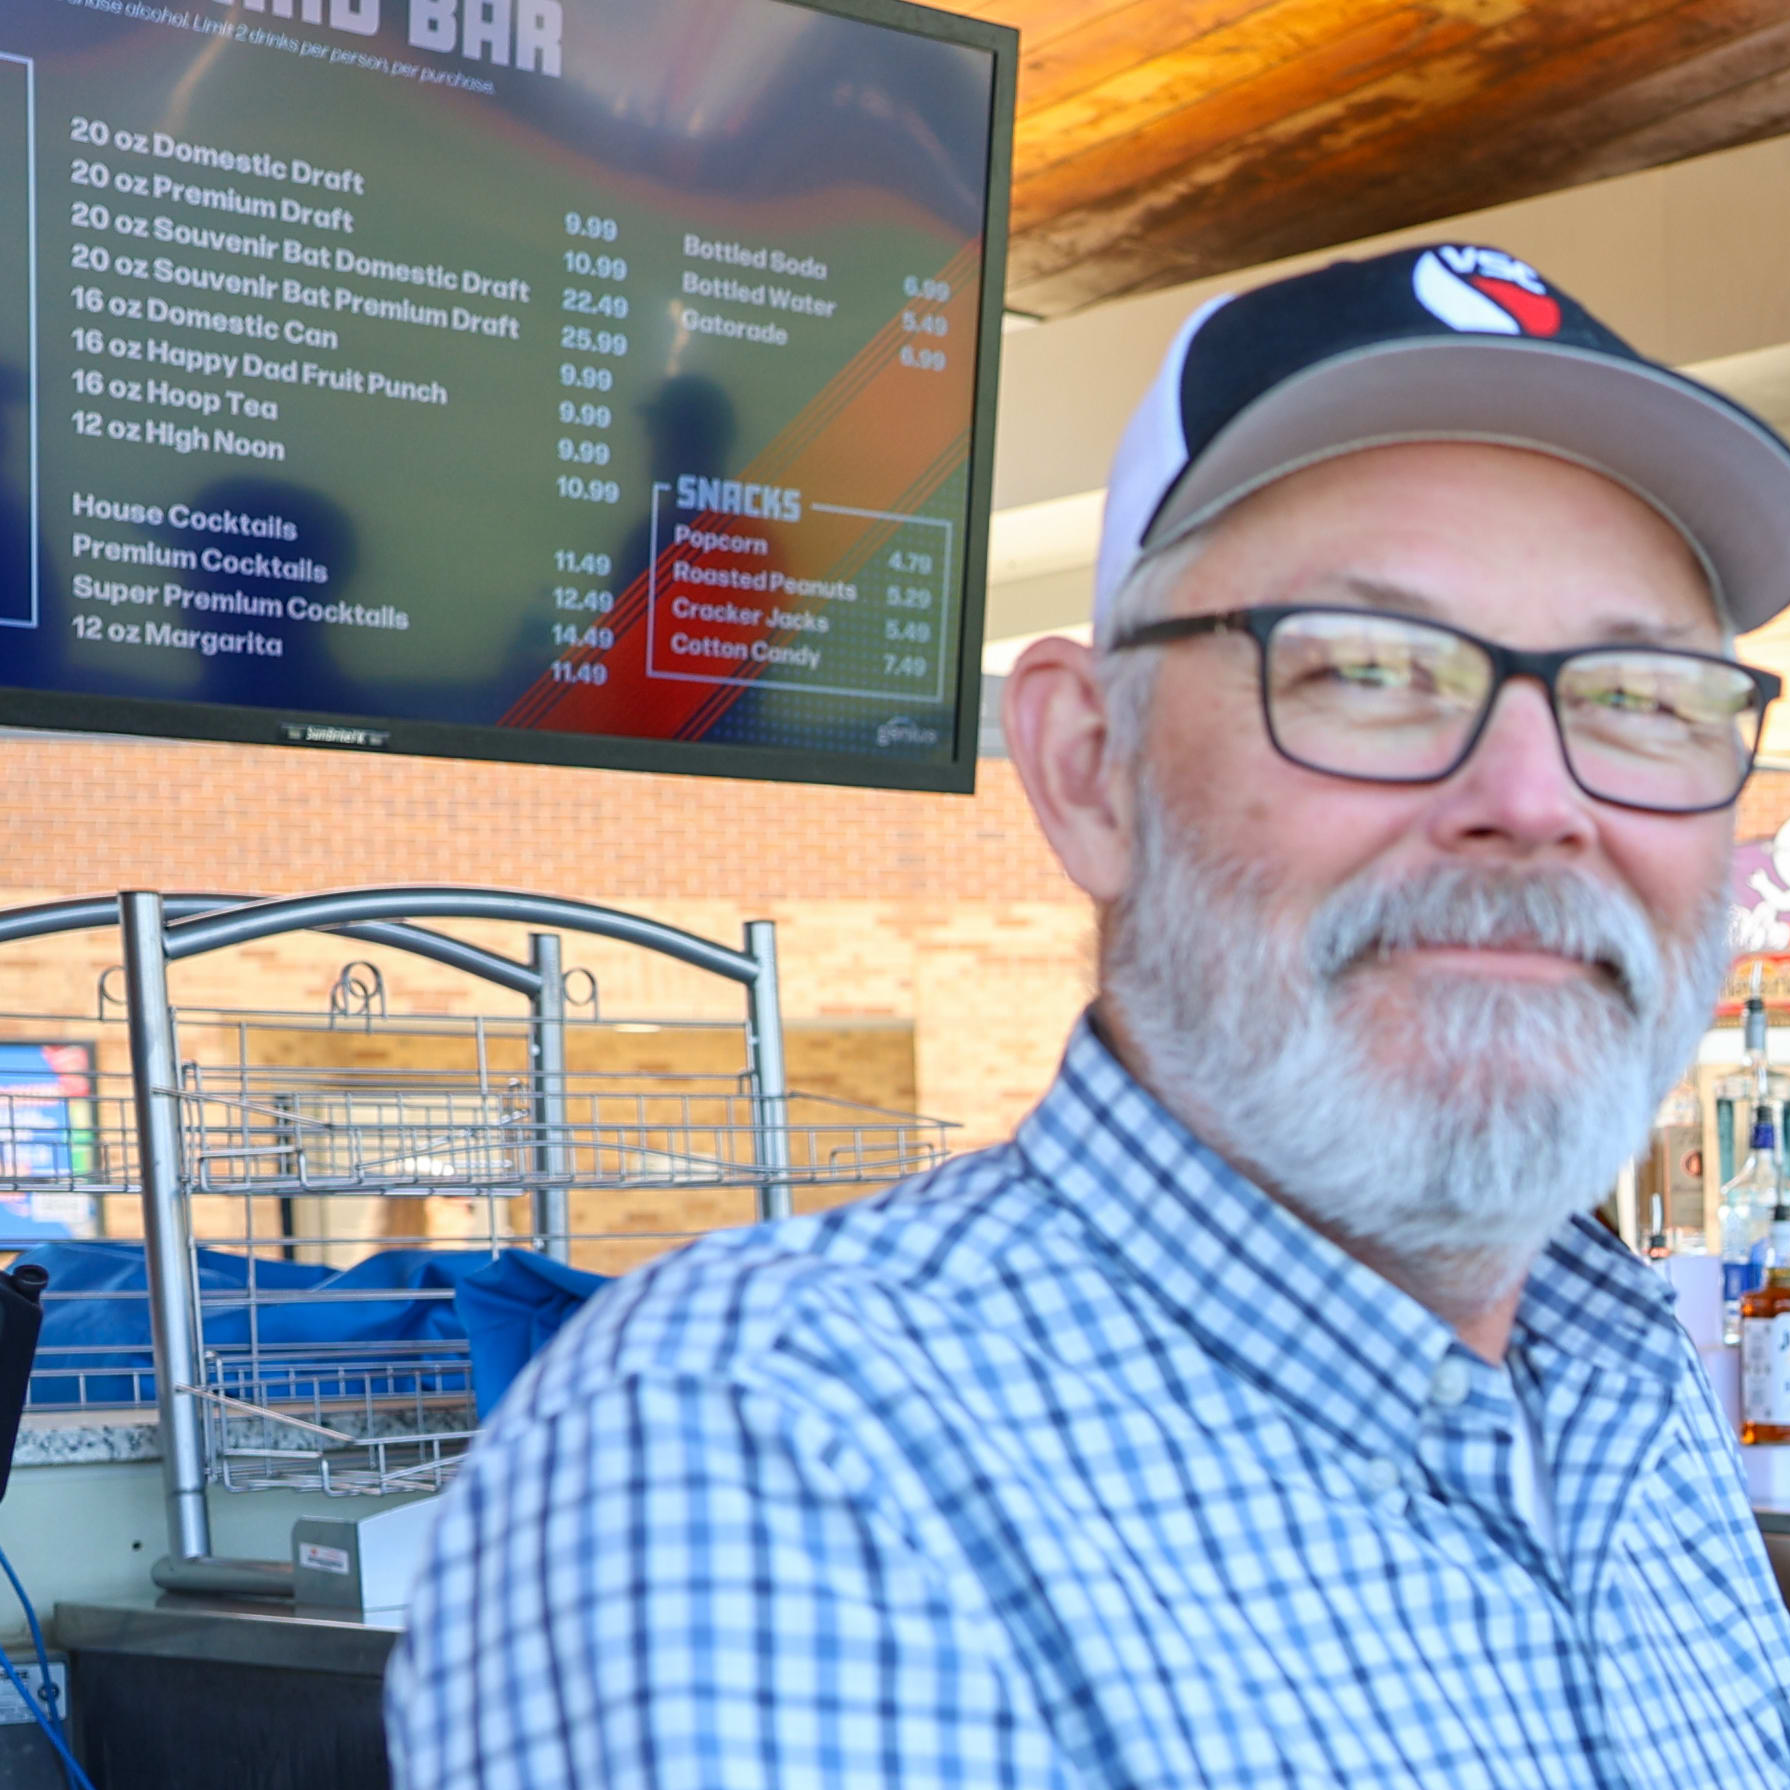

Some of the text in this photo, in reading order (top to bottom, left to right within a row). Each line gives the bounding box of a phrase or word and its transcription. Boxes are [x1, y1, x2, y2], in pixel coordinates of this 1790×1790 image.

[235, 23, 249, 42] 2
[249, 26, 300, 51] drinks
[300, 40, 330, 59] per
[390, 60, 420, 79] per
[408, 0, 562, 78] BAR
[70, 116, 364, 195] 20 oz Domestic Draft
[70, 158, 354, 233] 20 oz Premium Draft
[564, 211, 618, 242] 9.99
[71, 201, 530, 303] 20 oz Souvenir Bat Domestic Draft
[563, 250, 628, 282] 10.99
[683, 234, 827, 280] Bottled Soda
[1438, 245, 1547, 296] VSC
[71, 243, 520, 340] 20 oz Souvenir Bat Premium Draft
[562, 287, 629, 319] 22.49
[682, 271, 836, 318] Bottled Water
[70, 285, 338, 349] 16 oz Domestic Can
[681, 308, 788, 346] Gatorade
[561, 325, 628, 356] 25.99
[71, 327, 448, 406] 16 oz Happy Dad Fruit Punch
[559, 363, 613, 392] 9.99
[71, 368, 279, 420] 16 oz Hoop Tea
[558, 400, 611, 429] 9.99
[71, 410, 285, 461] 12 oz High Noon
[557, 437, 611, 466] 9.99
[556, 475, 620, 504] 10.99
[675, 474, 801, 522] SNACKS
[73, 492, 298, 541] House Cocktails
[73, 533, 328, 584] Premium Cocktails
[673, 523, 768, 556] Popcorn
[554, 550, 612, 577] 11.49
[673, 560, 857, 602] Roasted Peanuts
[73, 574, 410, 631] Super Premium Cocktails
[552, 587, 614, 614] 12.49
[672, 596, 830, 634] Cracker Jacks
[71, 615, 283, 657] 12 oz Margarita
[552, 624, 614, 651] 14.49
[670, 633, 821, 670] Cotton Candy
[551, 661, 608, 686] 11.49
